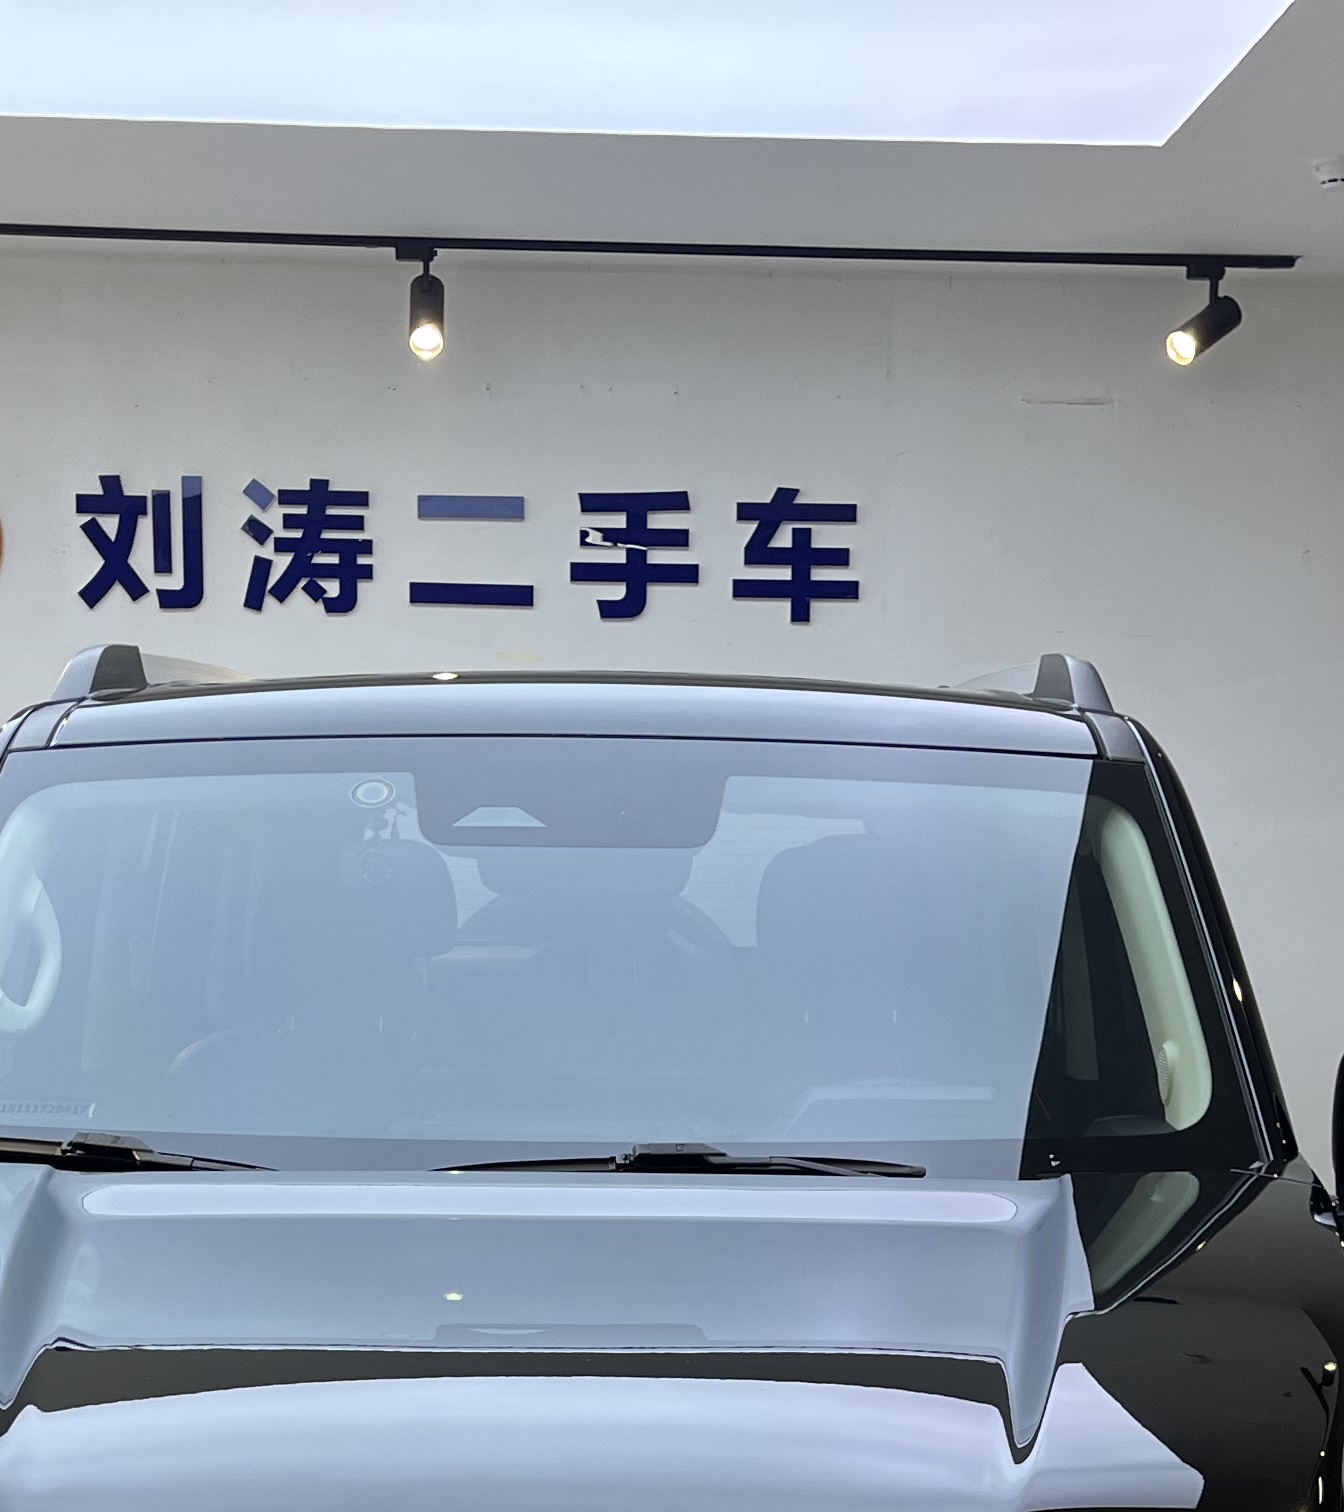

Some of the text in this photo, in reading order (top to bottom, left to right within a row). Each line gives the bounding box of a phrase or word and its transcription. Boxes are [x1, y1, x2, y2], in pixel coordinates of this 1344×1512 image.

[75, 474, 862, 623] 刘涛二手车
